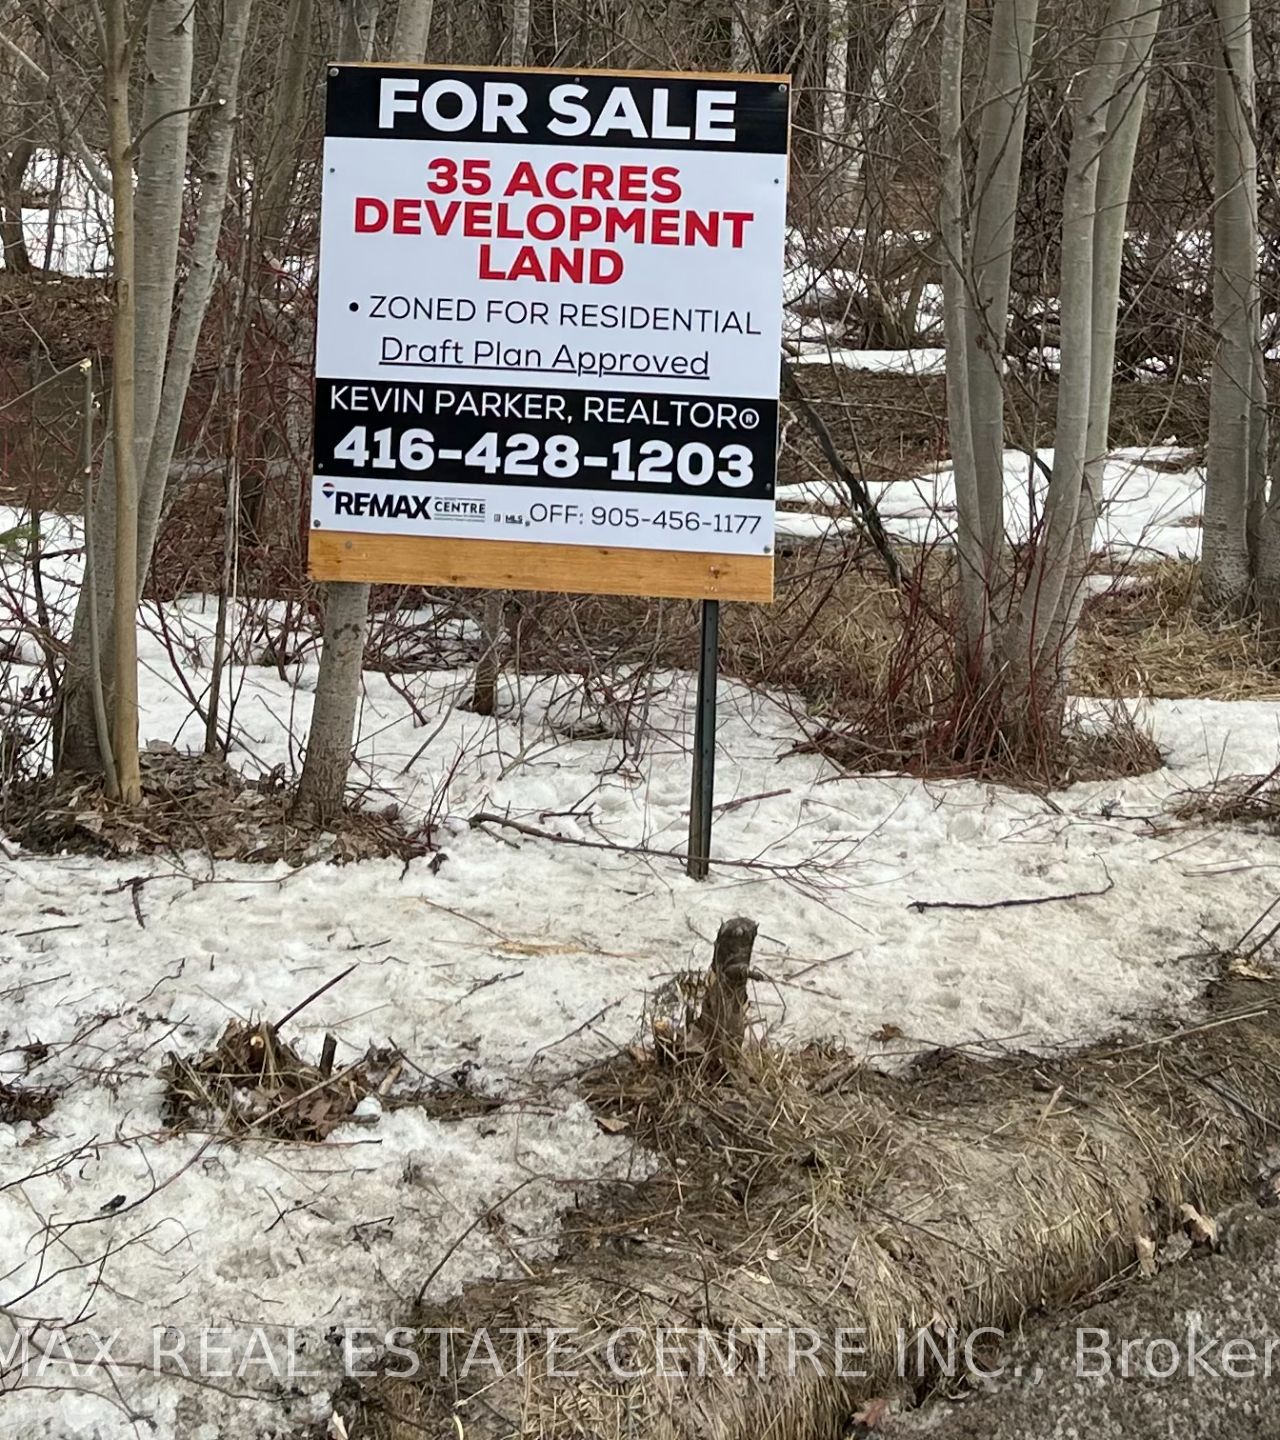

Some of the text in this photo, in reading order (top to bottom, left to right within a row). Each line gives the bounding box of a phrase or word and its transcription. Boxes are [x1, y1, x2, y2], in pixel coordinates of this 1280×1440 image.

[378, 78, 737, 142] FOR SALE
[427, 158, 683, 203] 35 ACRES
[354, 197, 754, 249] DEVELOPMENT
[478, 244, 626, 285] LAND
[368, 295, 762, 335] ZONED FOR RESIDENTIAL
[381, 336, 710, 377] Draft Plan Approved
[330, 385, 424, 414] KEVIN
[434, 391, 574, 424] PARKER,
[333, 425, 754, 488] 416-428-1203
[434, 501, 486, 514] CENTRE
[529, 503, 762, 535] OFF: 905-456-1177
